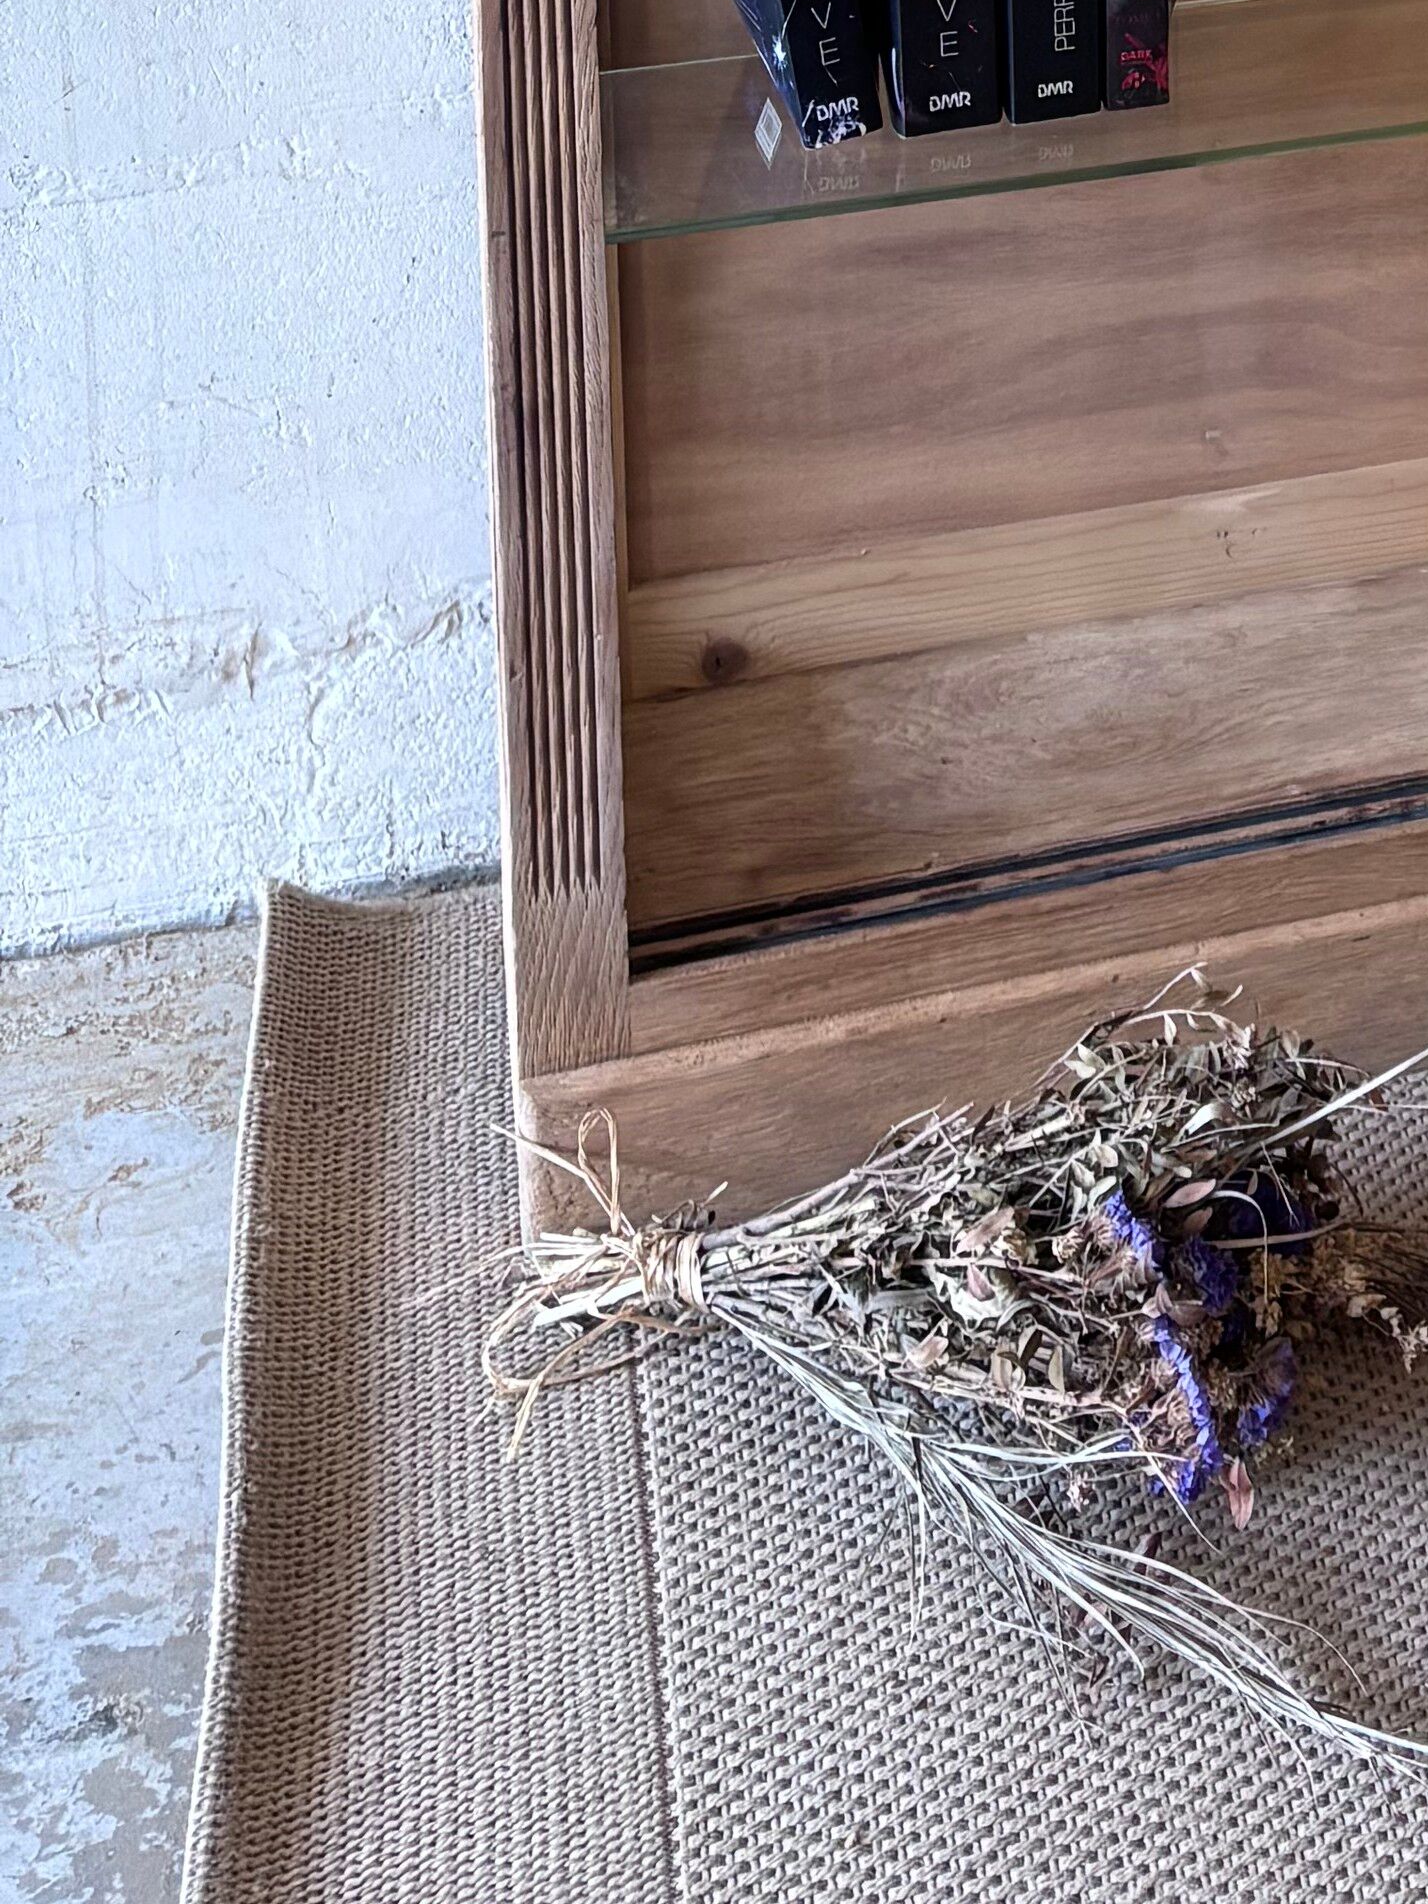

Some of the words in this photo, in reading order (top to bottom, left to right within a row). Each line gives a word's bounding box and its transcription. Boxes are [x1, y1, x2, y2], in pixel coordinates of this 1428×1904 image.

[1037, 80, 1074, 98] DMR
[815, 96, 860, 122] DMR
[929, 91, 972, 113] DMR
